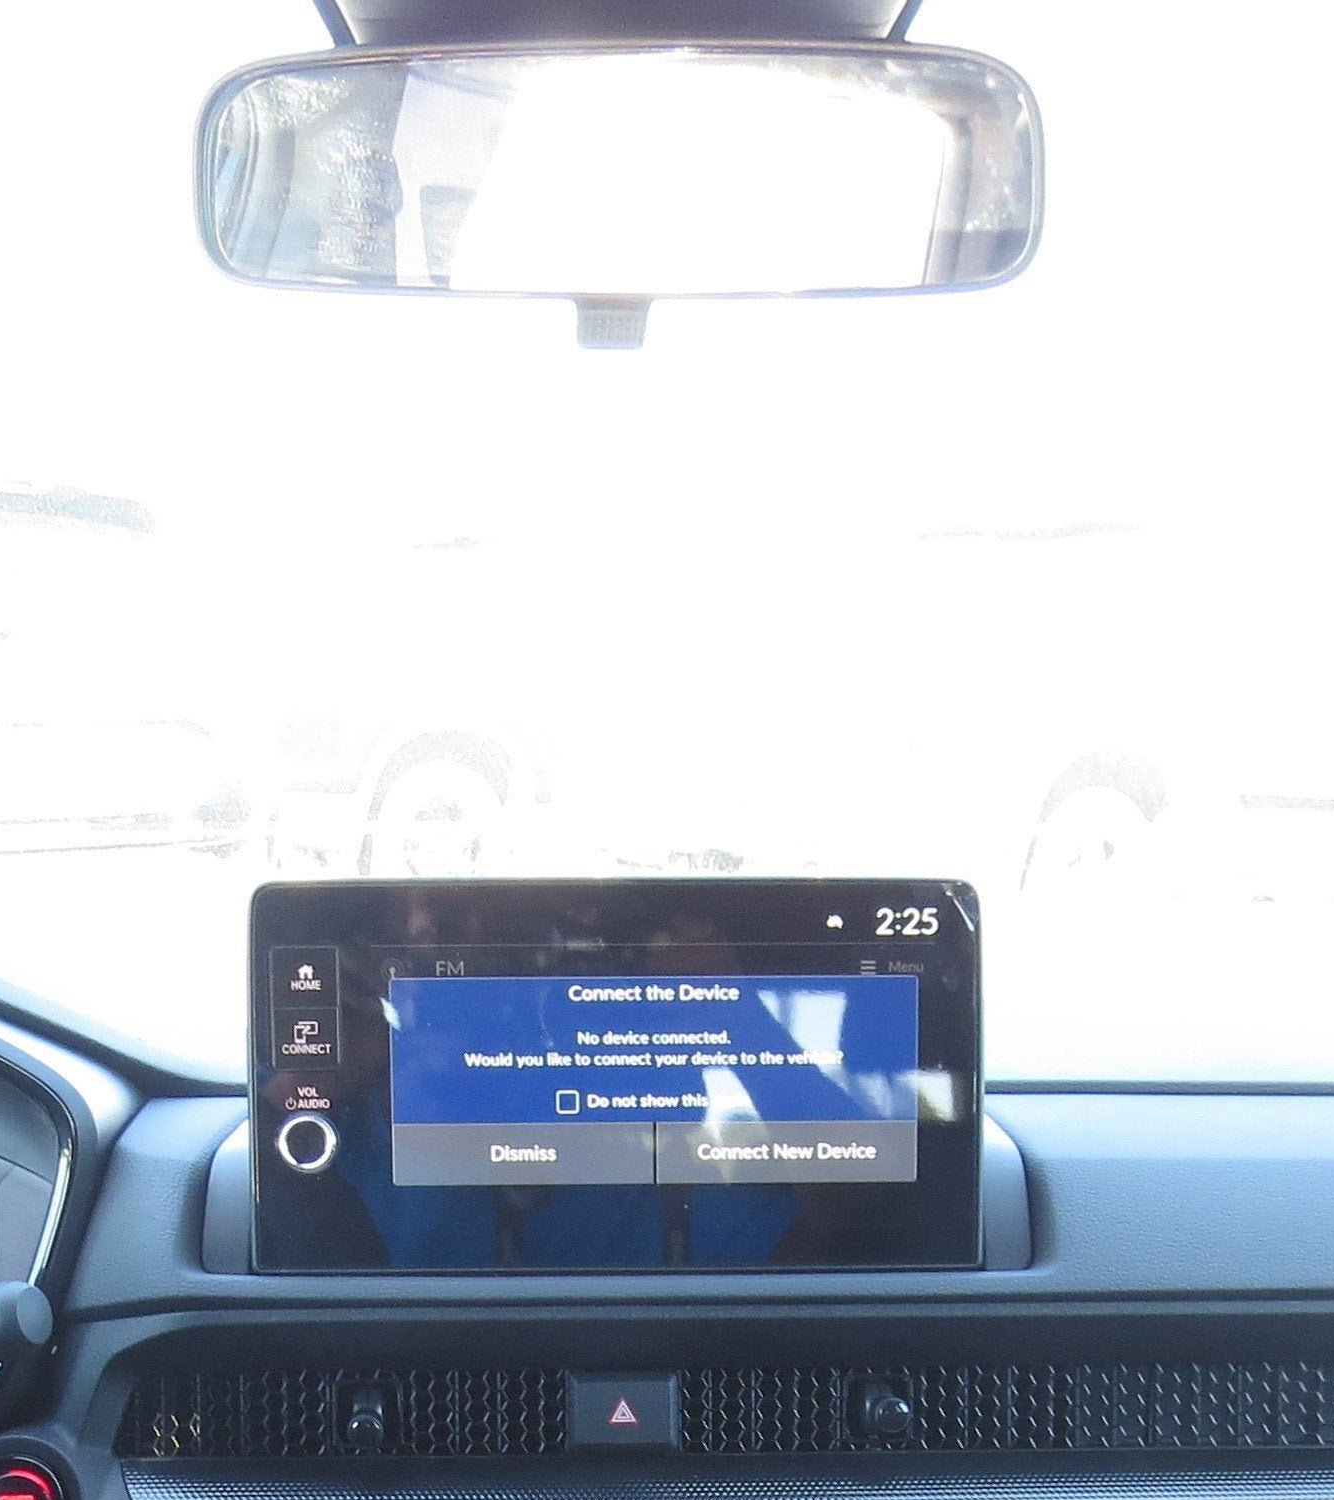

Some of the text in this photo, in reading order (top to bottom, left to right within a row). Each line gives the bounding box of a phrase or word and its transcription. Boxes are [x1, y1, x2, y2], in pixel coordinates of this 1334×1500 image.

[875, 907, 939, 936] 2:25
[435, 961, 465, 976] FM
[888, 960, 924, 973] Menu
[290, 980, 322, 991] HOME
[568, 984, 740, 1001] Connect the Device
[577, 1029, 731, 1045] No device connected.
[281, 1044, 332, 1055] CONNECT
[464, 1050, 845, 1069] Would you like to connect your device to the vehe?
[297, 1086, 319, 1098] VOL
[297, 1099, 331, 1110] AUDIO
[586, 1093, 710, 1109] Do not show this
[490, 1144, 557, 1163] Dismiss
[697, 1143, 877, 1161] Connect New Device
